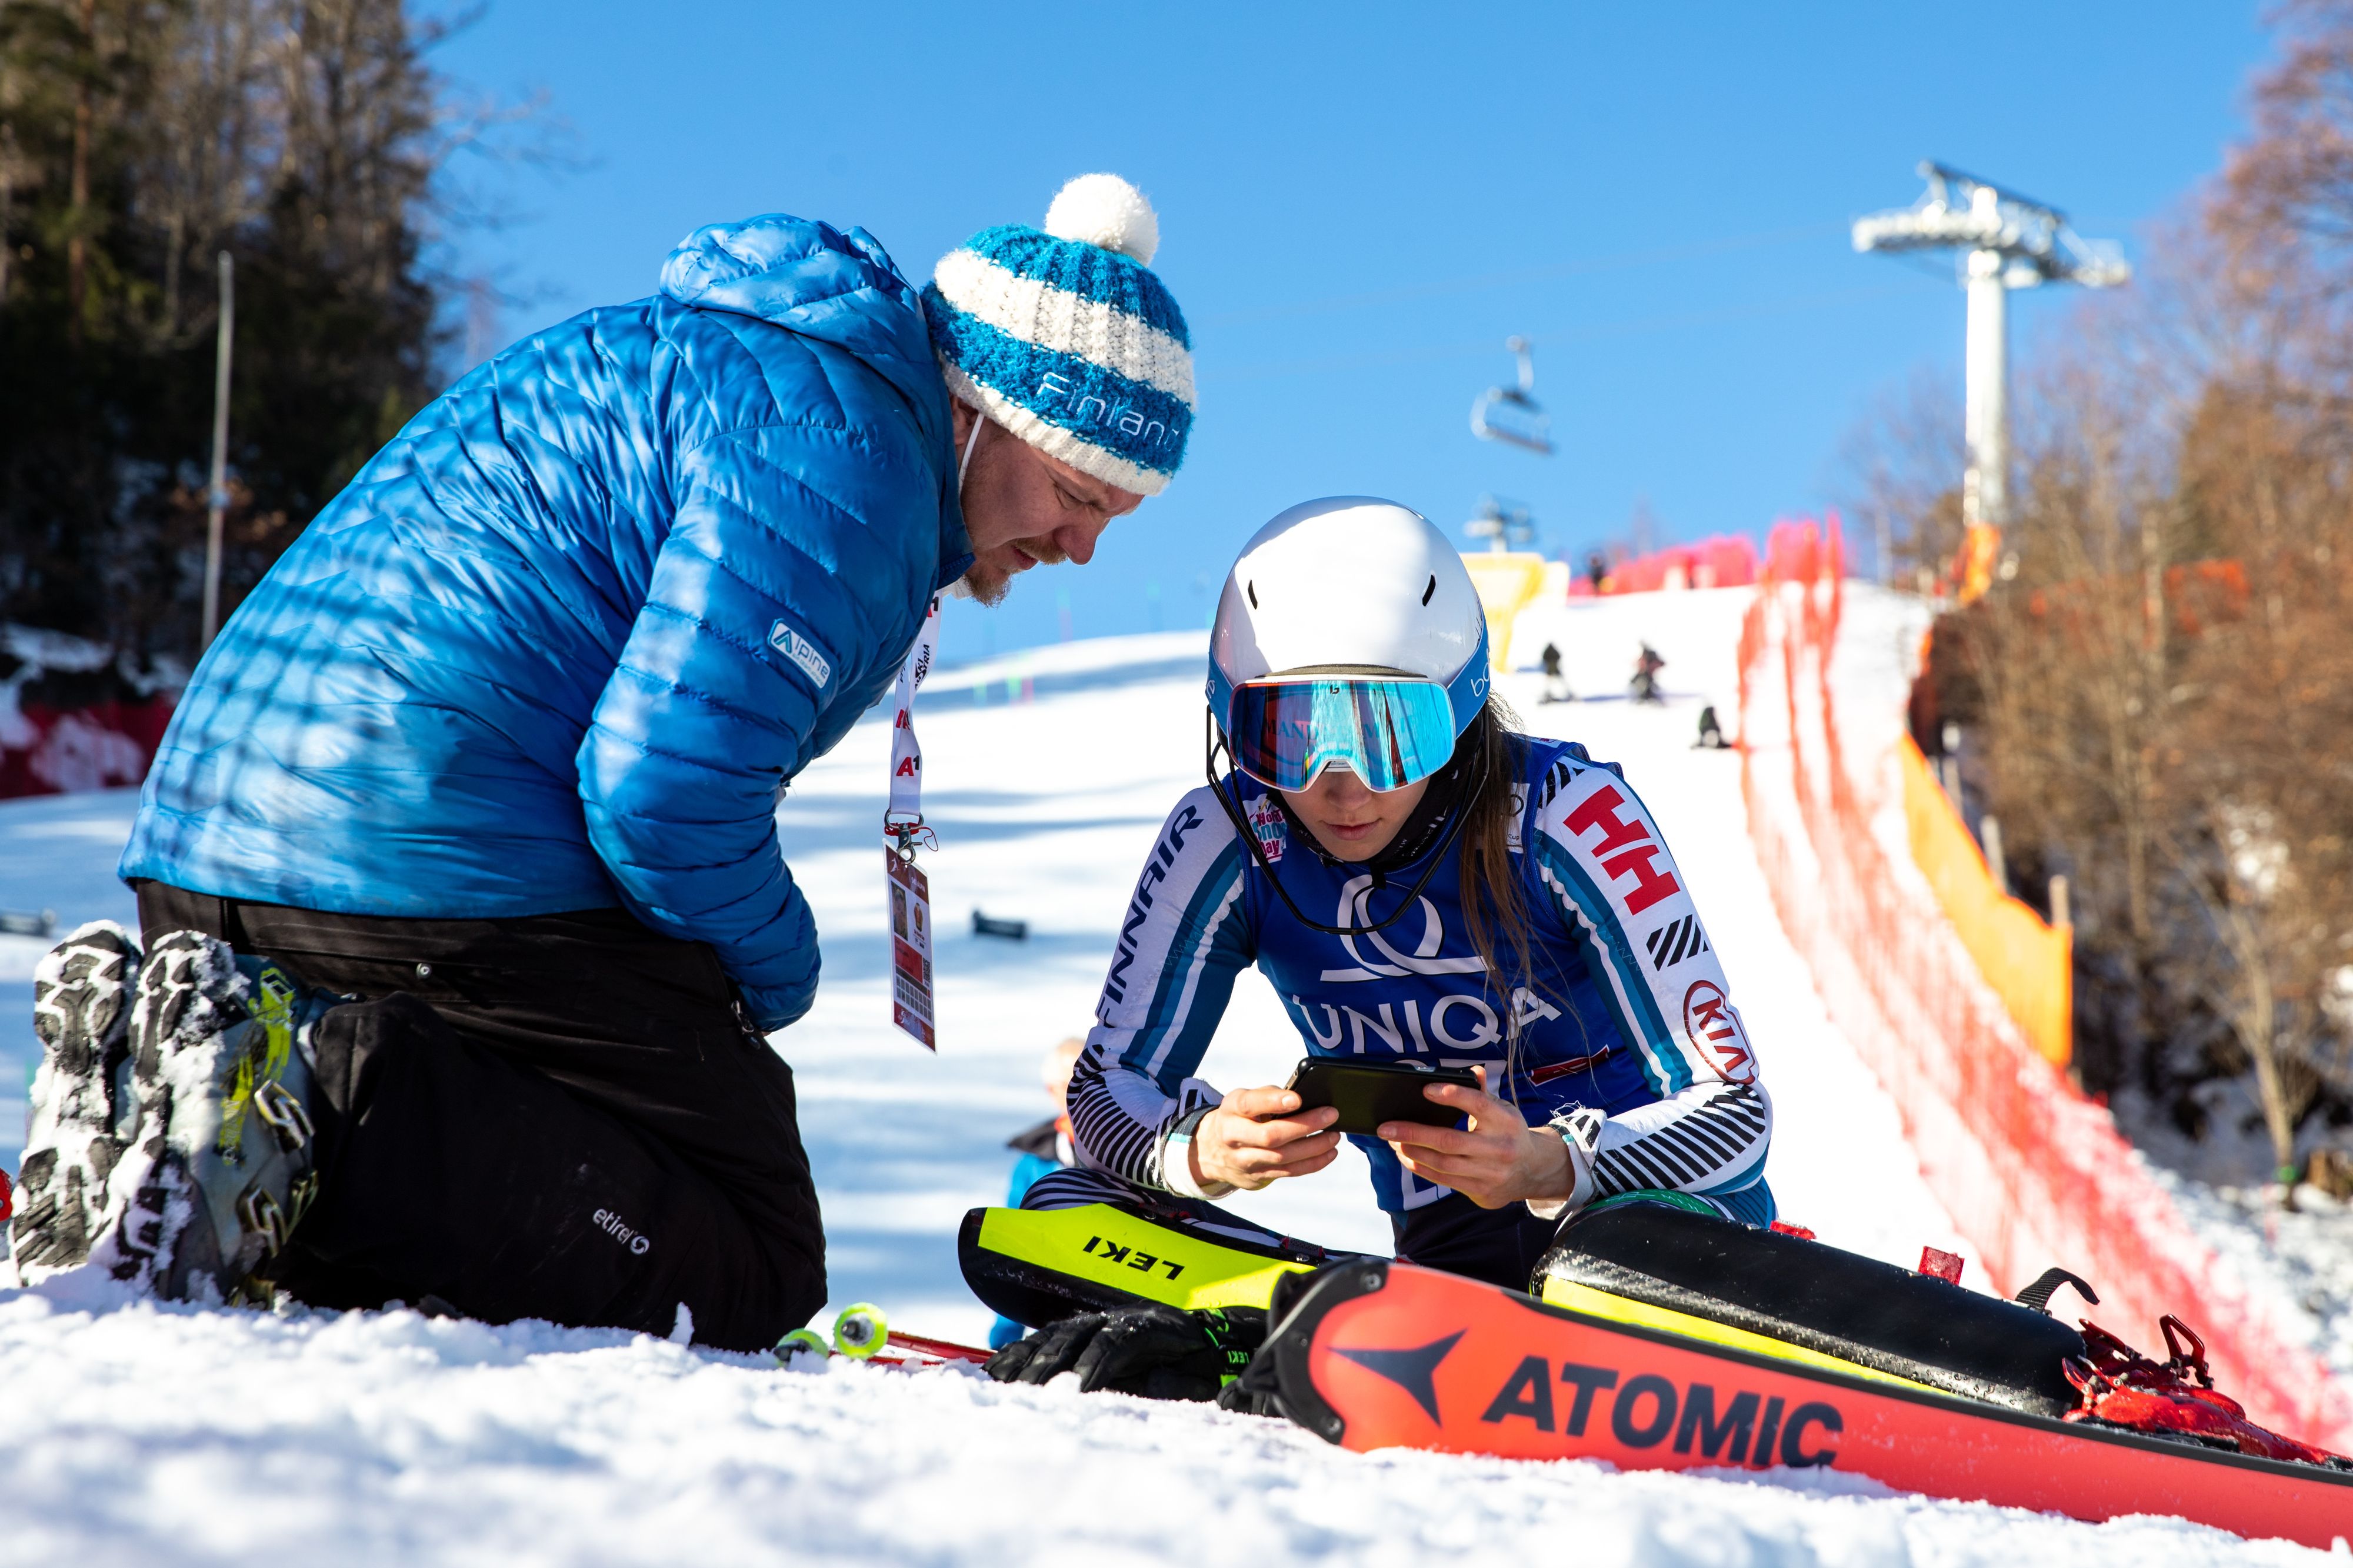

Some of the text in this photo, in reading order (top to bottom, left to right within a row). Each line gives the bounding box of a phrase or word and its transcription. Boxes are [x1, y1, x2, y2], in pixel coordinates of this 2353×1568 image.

[896, 755, 920, 777] A1
[1562, 784, 1681, 916] HH
[1096, 805, 1204, 1029] FINNAIR
[1292, 986, 1562, 1054] UNIQA
[1691, 995, 1749, 1073] KIA
[1082, 1235, 1185, 1281] LEKI
[1481, 1355, 1844, 1468] ATOMIC
